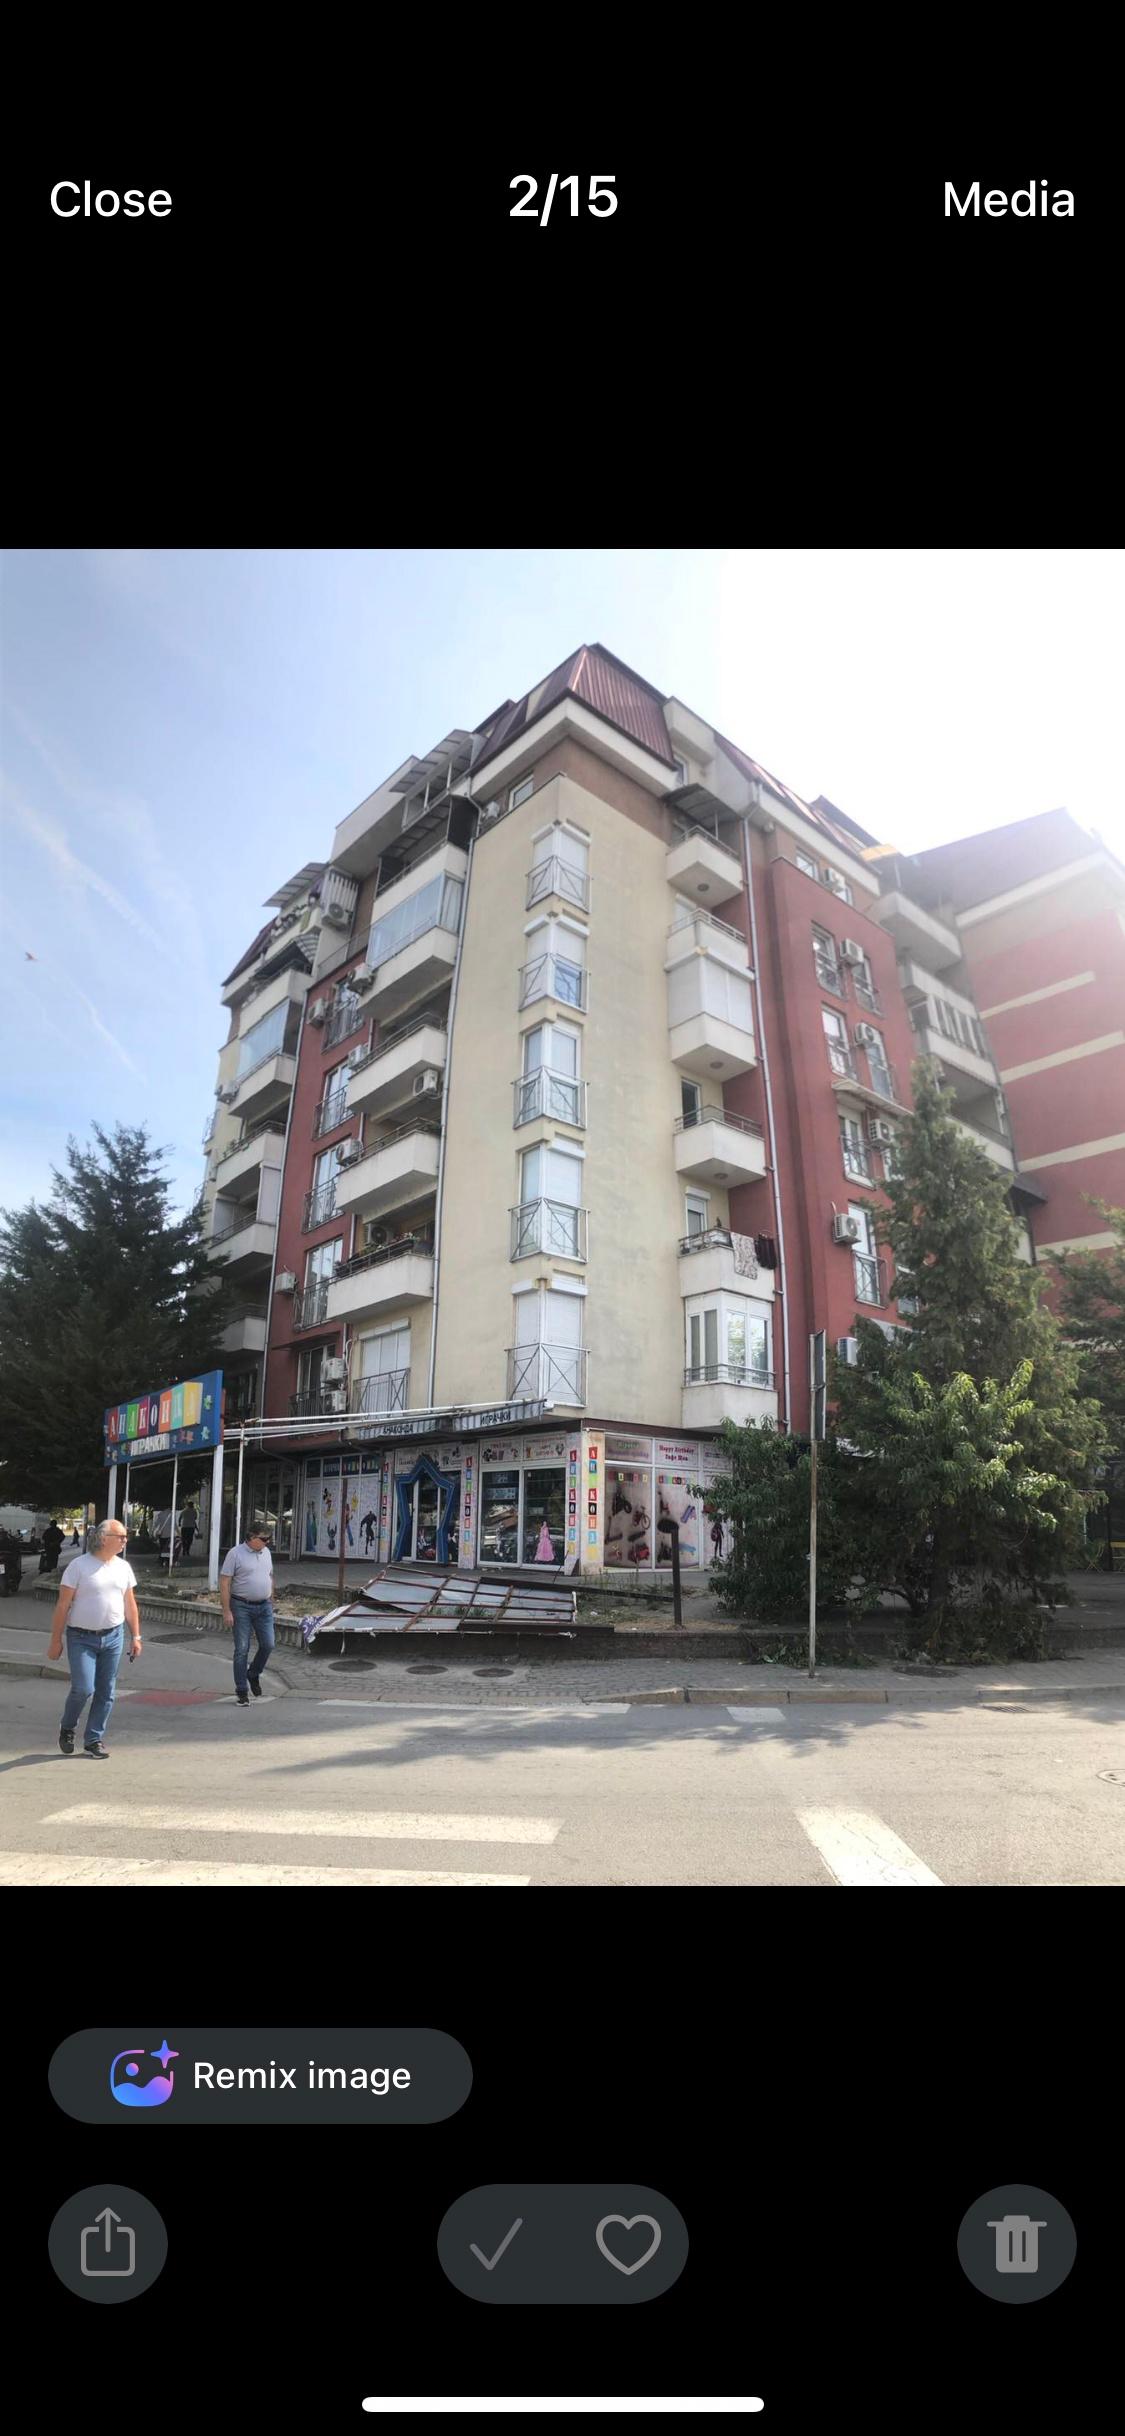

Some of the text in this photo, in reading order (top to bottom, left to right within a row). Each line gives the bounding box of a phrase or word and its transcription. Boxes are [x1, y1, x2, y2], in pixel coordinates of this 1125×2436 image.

[110, 1388, 201, 1439] АНАКОНДА
[480, 1410, 511, 1425] ИГРАЧКИ
[383, 1424, 413, 1434] АНАКОНДА
